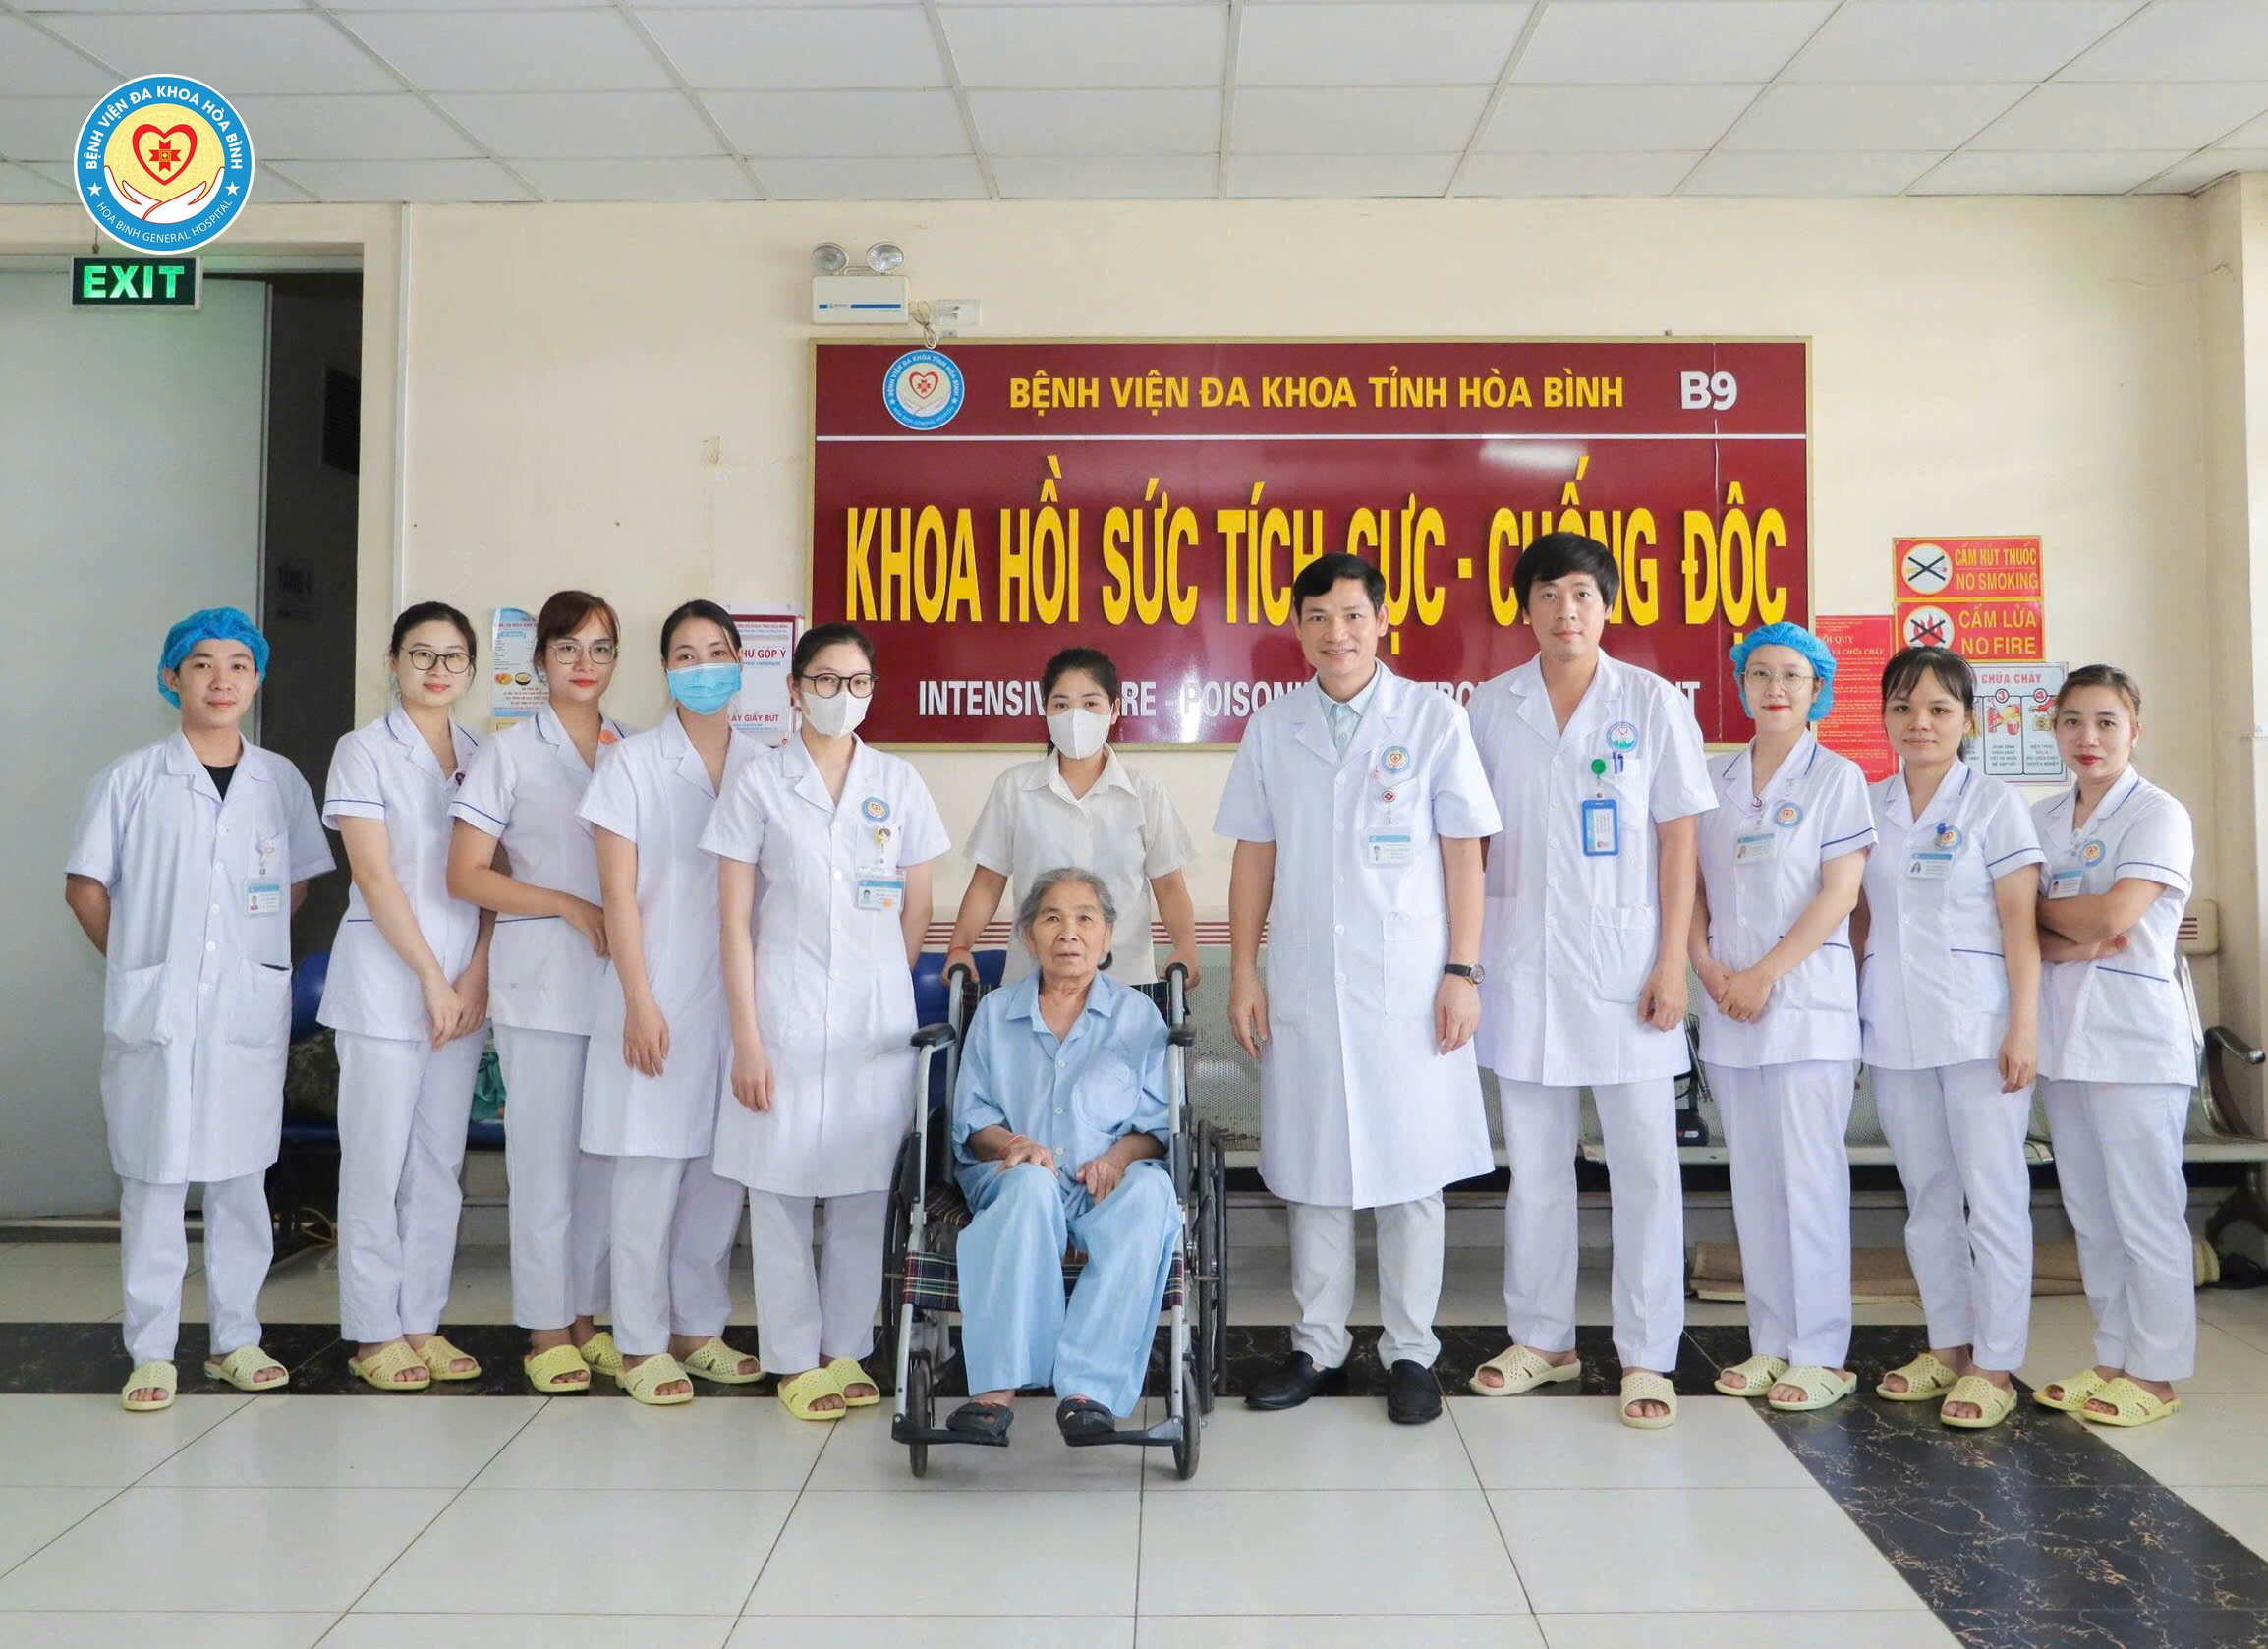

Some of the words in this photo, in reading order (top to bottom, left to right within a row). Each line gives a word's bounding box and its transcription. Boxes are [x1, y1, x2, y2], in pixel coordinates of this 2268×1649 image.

[84, 265, 185, 299] EXIT
[1010, 370, 1099, 416] BỆNH
[1110, 370, 1188, 416] VIỆN
[1199, 376, 1251, 408] ĐA
[1262, 376, 1357, 408] KHOA
[1368, 366, 1447, 408] TỈNH
[1459, 368, 1533, 408] HÒA
[1543, 368, 1623, 408] BÌNH
[1680, 371, 1737, 411] B9
[846, 505, 983, 624] KHOA
[999, 455, 1079, 625] HỒI
[1102, 478, 1200, 626] SỨC
[1681, 481, 1786, 645] ĐỘC
[1956, 542, 1977, 566] CẤM
[2003, 541, 2036, 566] THUỐC
[1956, 573, 1975, 590] NO
[1978, 572, 2038, 591] SMOKING
[1958, 603, 1997, 628] CẤM
[2003, 604, 2036, 628] LỬA
[758, 647, 777, 658] GÓP
[780, 648, 786, 658] Ý
[1961, 637, 1989, 654] NO
[1993, 637, 2036, 654] FIRE
[1999, 691, 2006, 701] 3
[2036, 691, 2044, 700] 4
